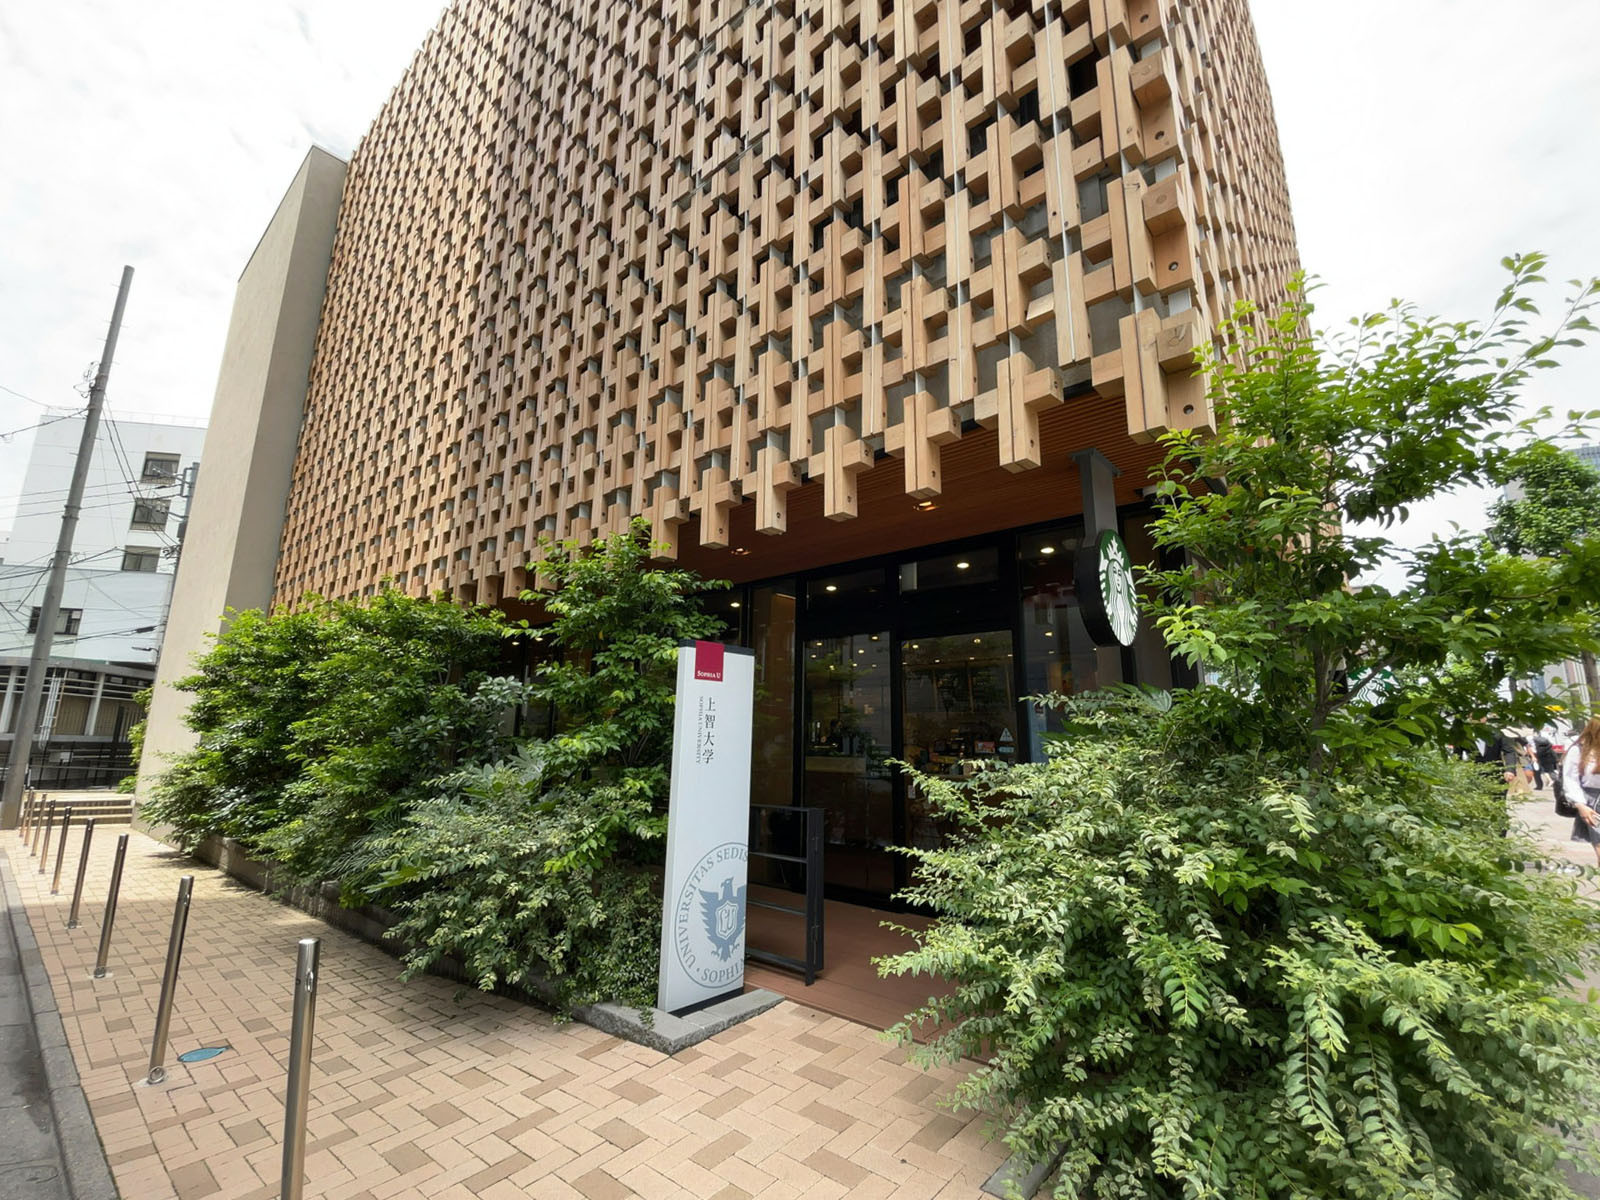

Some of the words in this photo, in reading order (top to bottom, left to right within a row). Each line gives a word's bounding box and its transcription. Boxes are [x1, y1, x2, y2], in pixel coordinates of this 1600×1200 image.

[702, 697, 716, 764] 上智大学
[678, 858, 714, 969] UNIVERSITAS
